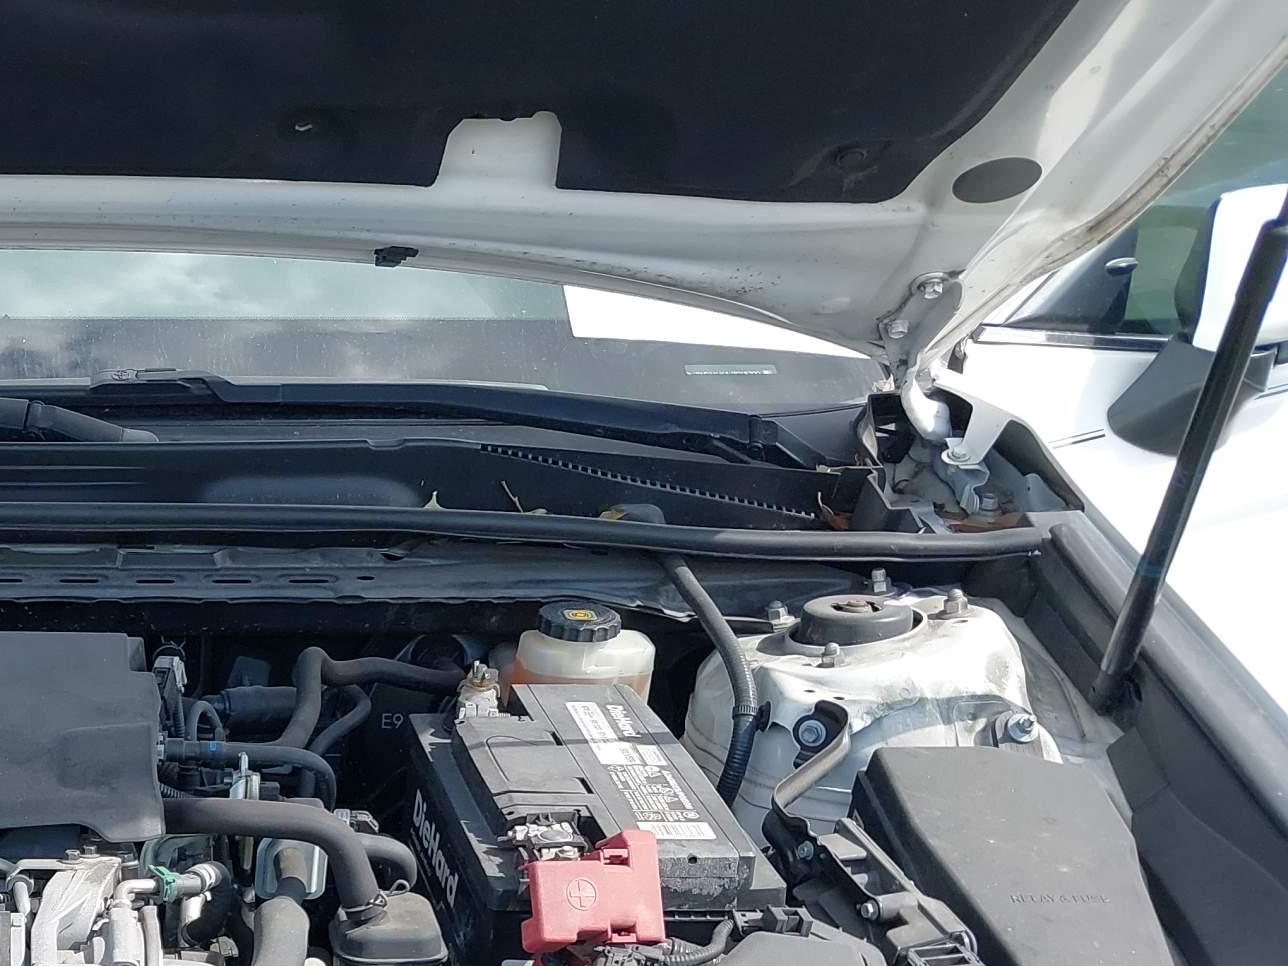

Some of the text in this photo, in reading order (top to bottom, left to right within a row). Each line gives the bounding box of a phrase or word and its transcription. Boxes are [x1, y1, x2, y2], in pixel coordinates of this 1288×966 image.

[382, 713, 404, 729] E9
[605, 704, 642, 739] DieHard
[413, 788, 459, 908] DieHard
